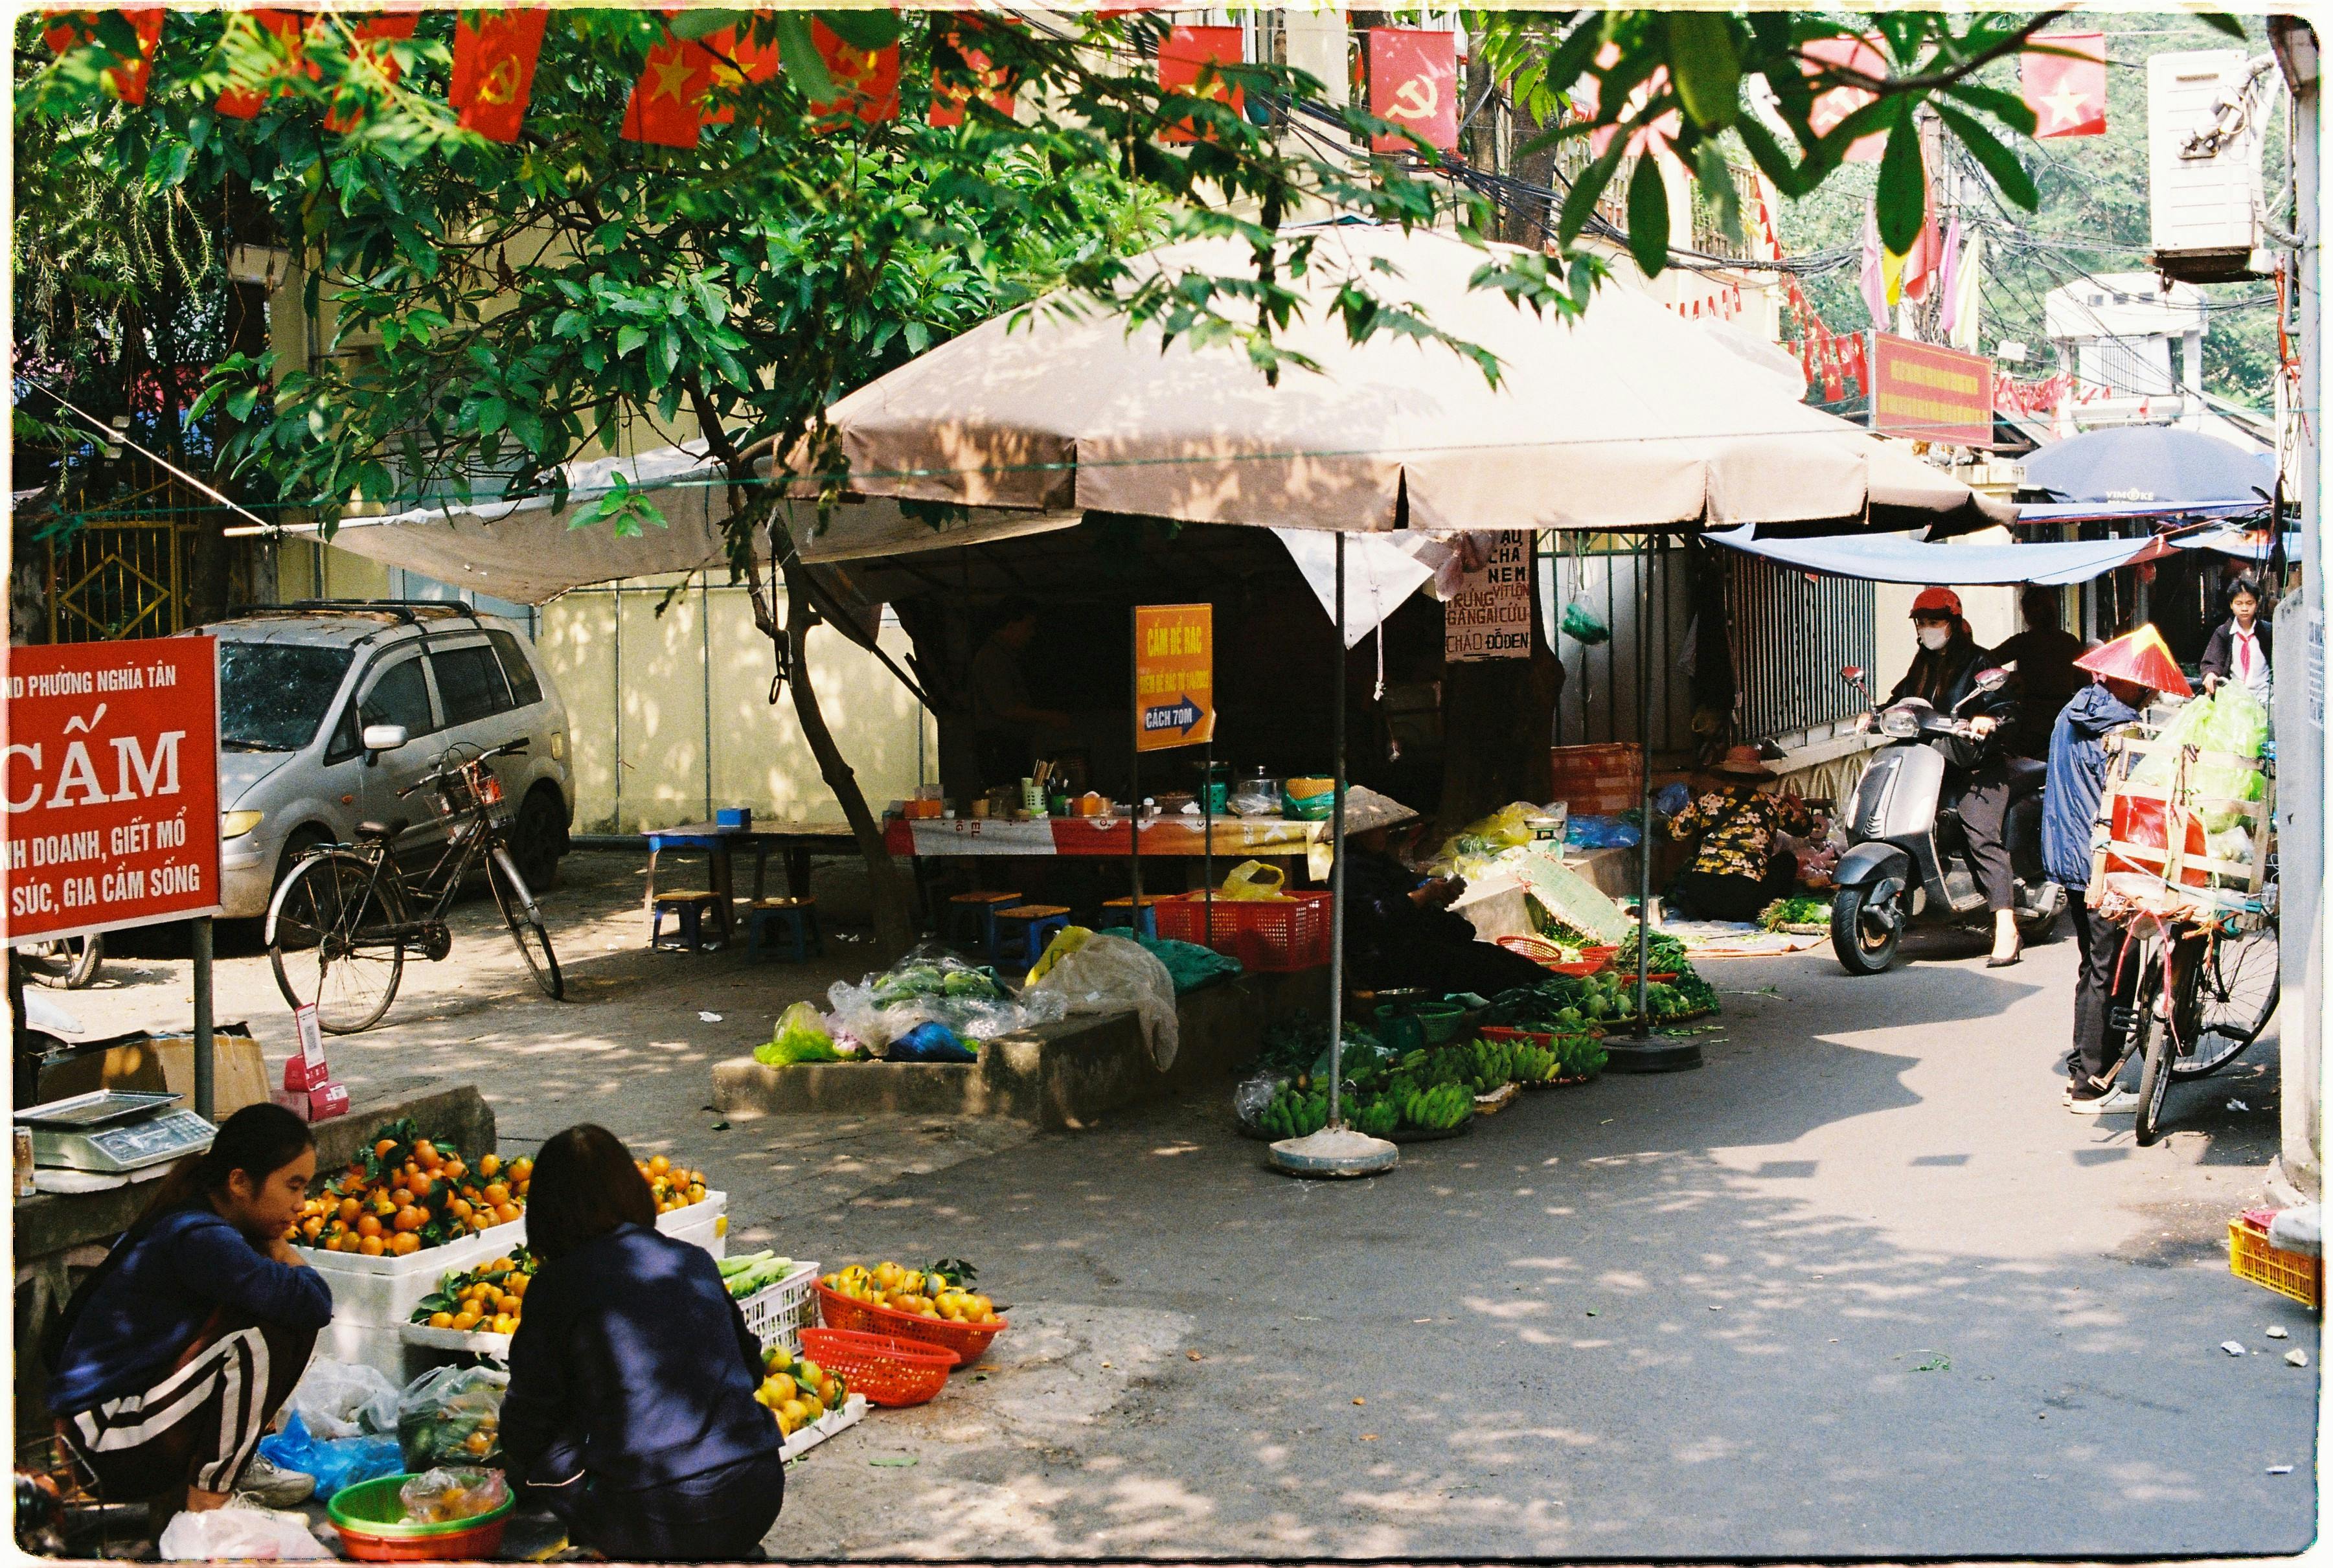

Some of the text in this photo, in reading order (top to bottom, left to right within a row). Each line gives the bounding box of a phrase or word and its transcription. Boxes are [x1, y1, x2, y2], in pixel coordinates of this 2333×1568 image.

[28, 665, 93, 698] PHƯỜNG
[97, 661, 143, 692] NGHĨA
[147, 659, 176, 688] TÂN
[1145, 708, 1192, 729] CÁCH 70M
[0, 703, 187, 814] CẤM
[32, 830, 108, 864] DOANH,
[111, 816, 151, 856] GIẾT
[157, 806, 187, 850] MỔ
[12, 876, 59, 917] SÚC,
[63, 876, 97, 907] GIA
[102, 861, 144, 903] CẦM
[150, 856, 200, 898] SỐNG
